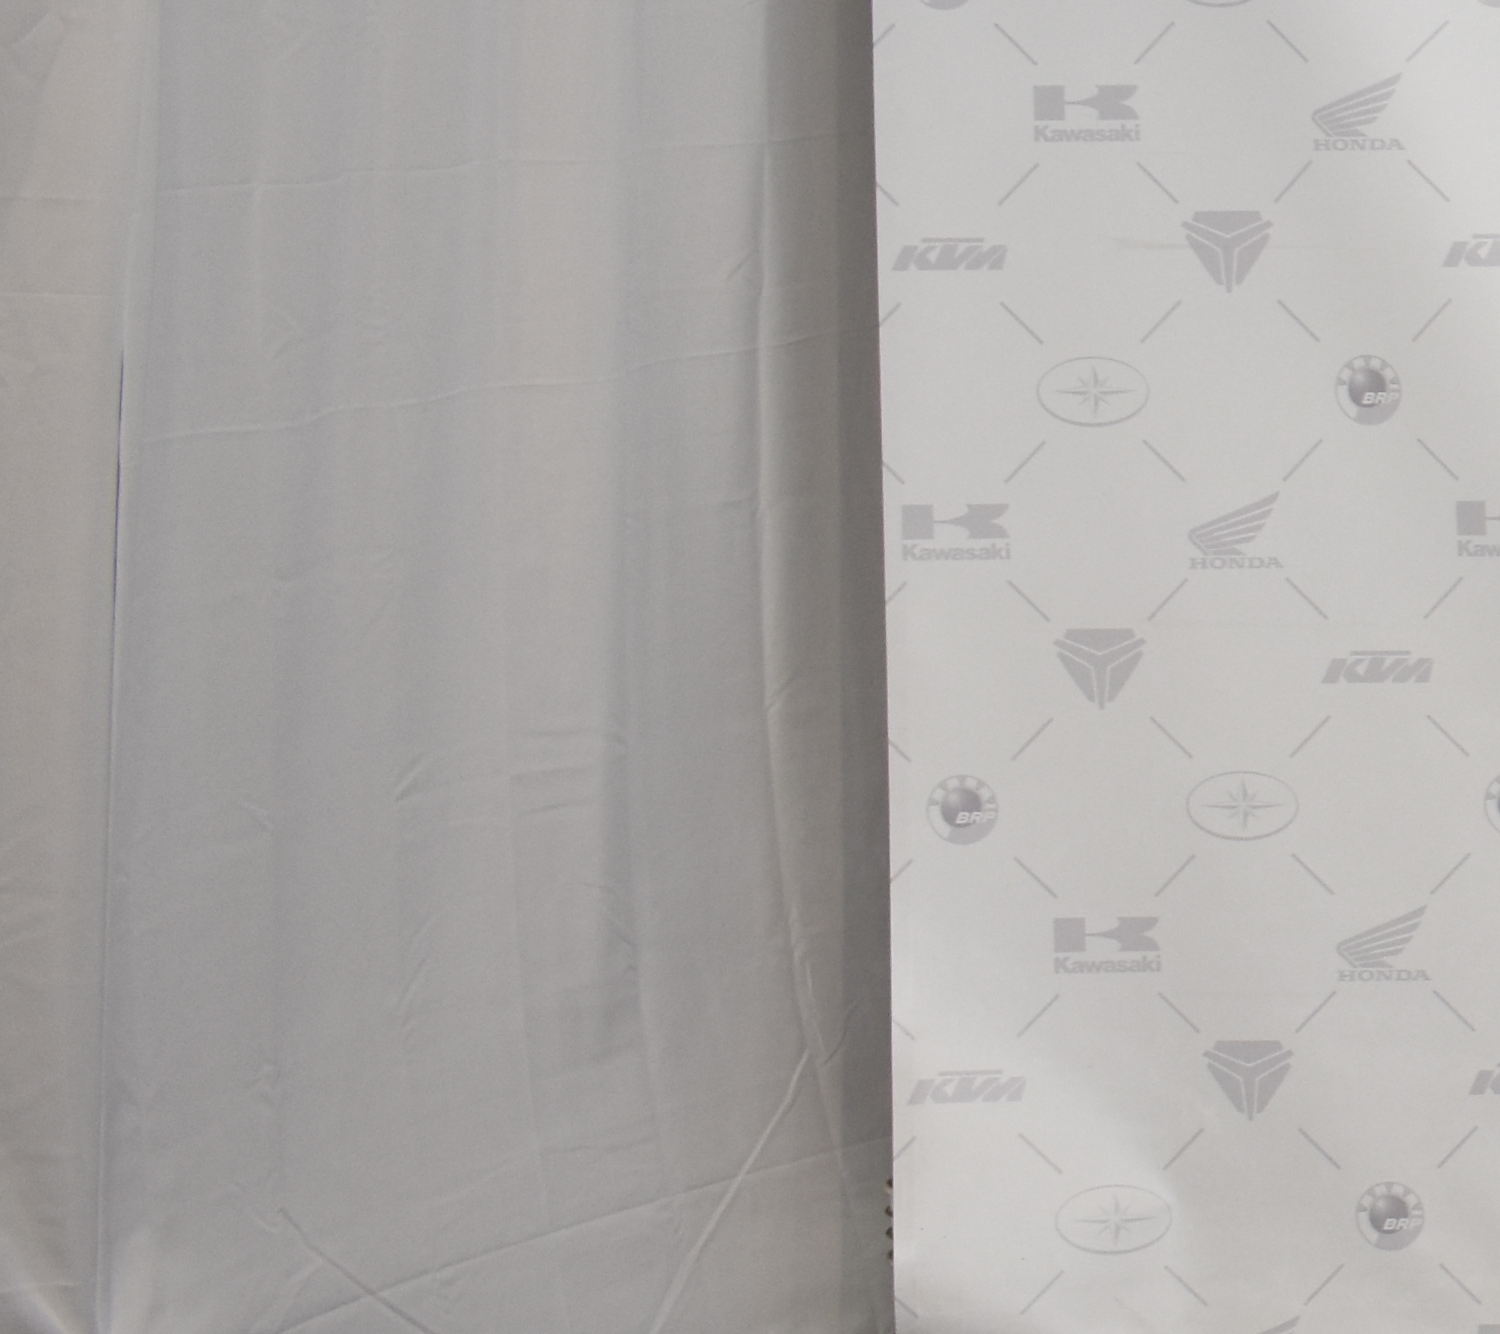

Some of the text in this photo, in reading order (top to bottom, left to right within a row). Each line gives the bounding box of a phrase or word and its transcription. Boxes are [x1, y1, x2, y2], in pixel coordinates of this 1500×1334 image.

[1032, 122, 1140, 144] Kawasaki
[1311, 136, 1405, 152] HONDA
[889, 237, 1010, 271] KTM
[899, 541, 1012, 563] Kawasaki
[1188, 555, 1285, 570] HONDA
[1320, 649, 1434, 685] KTM
[954, 810, 997, 826] BRP
[1053, 954, 1161, 975] Kawasaki
[1337, 968, 1431, 983] HONDA
[904, 1067, 1029, 1107] KTM
[1382, 1217, 1423, 1232] BRP
